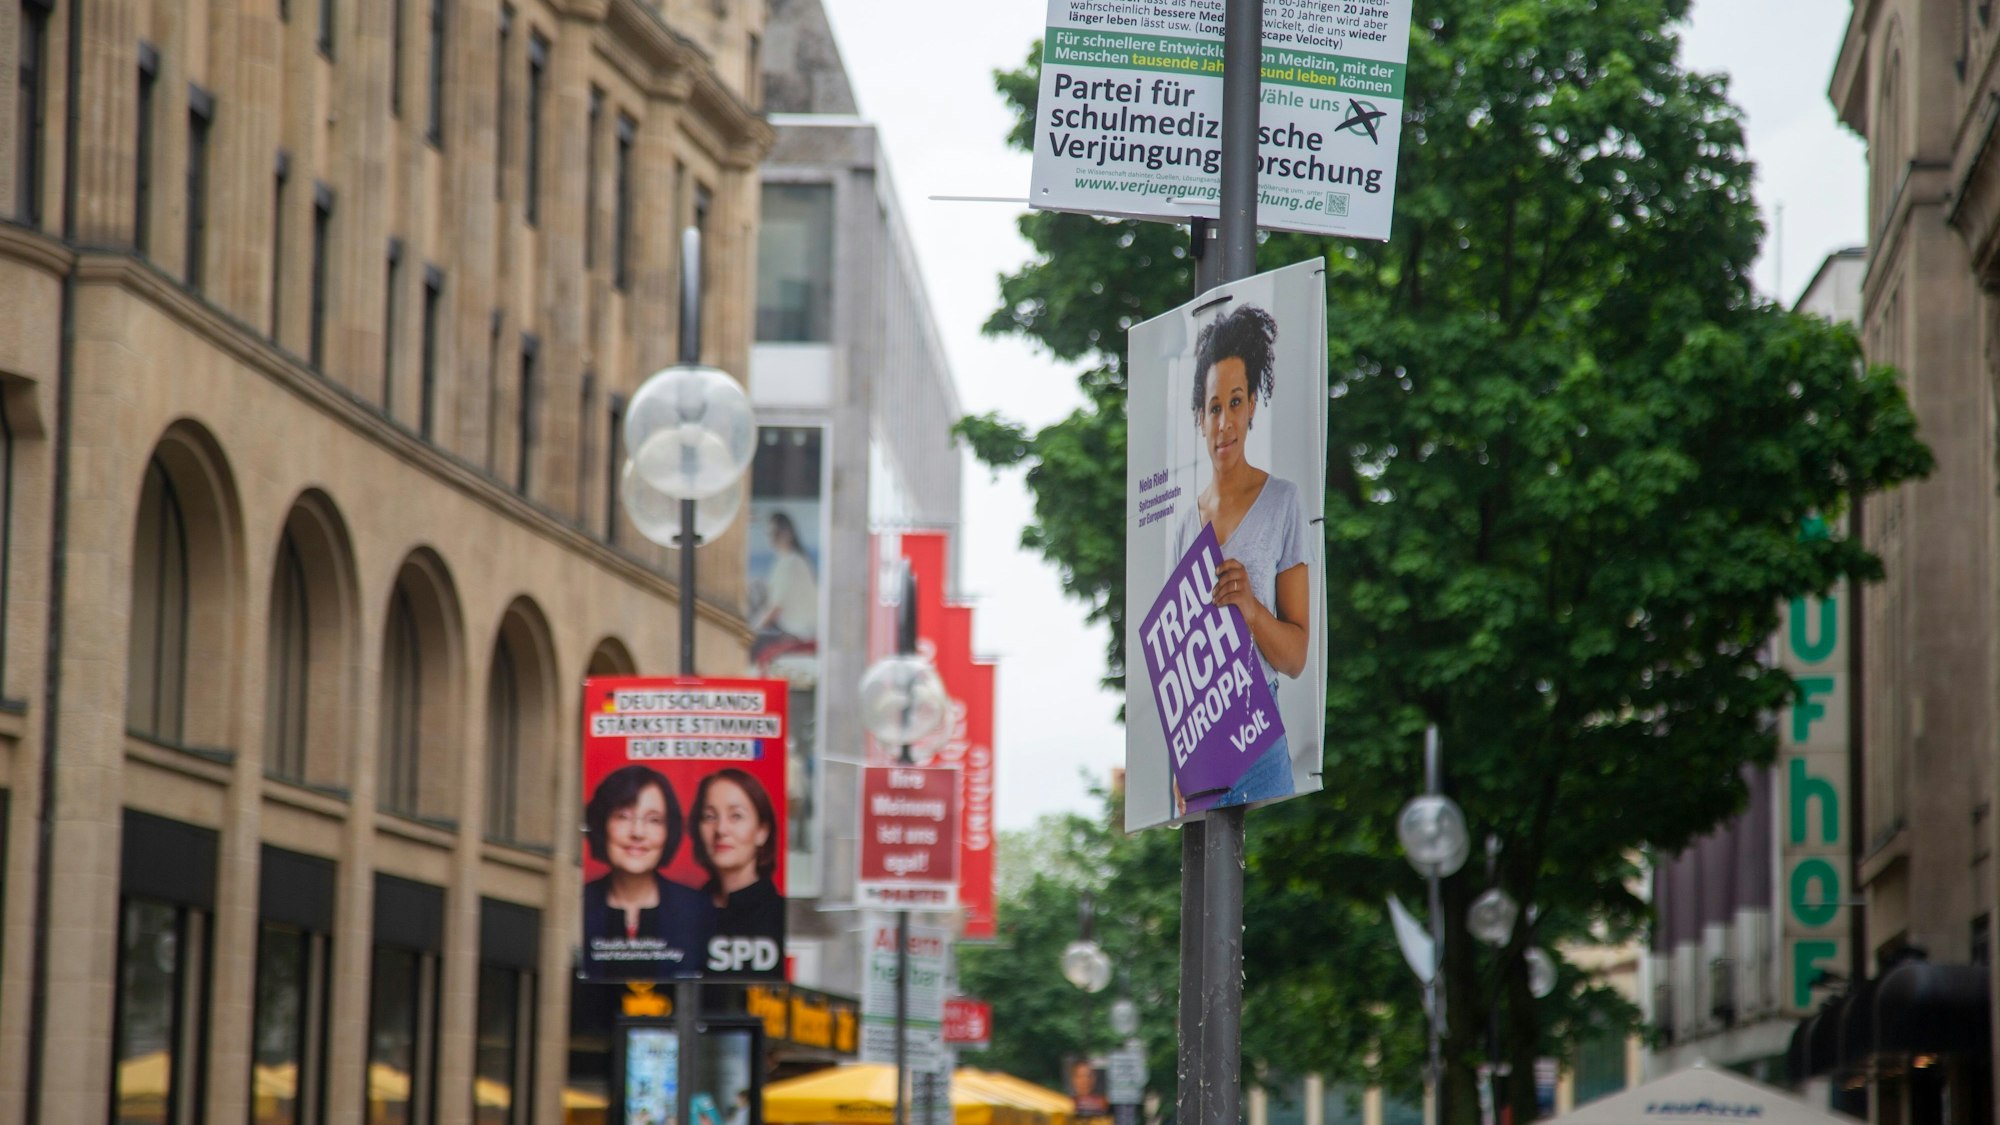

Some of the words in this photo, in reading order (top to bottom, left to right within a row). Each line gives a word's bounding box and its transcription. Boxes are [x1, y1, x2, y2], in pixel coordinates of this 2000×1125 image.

[1070, 2, 1150, 15] wahrscheinlich
[1153, 6, 1196, 20] bessere
[1263, 19, 1305, 33] wickelt,
[1307, 23, 1324, 34] die
[1327, 28, 1346, 37] uns
[1349, 29, 1387, 42] wieder
[1263, 8, 1277, 16] en
[1281, 8, 1295, 18] 20
[1297, 10, 1333, 23] Jahren
[1337, 16, 1360, 27] wird
[1363, 19, 1388, 30] aber
[1343, 4, 1357, 14] 20
[1359, 6, 1389, 19] Jahre
[1069, 11, 1103, 24] länger
[1106, 14, 1137, 26] leben
[1140, 16, 1165, 29] lässt
[1168, 21, 1191, 31] usw.
[1261, 31, 1293, 43] scape
[1295, 33, 1343, 50] Velocity)
[1055, 48, 1129, 64] Menschen
[1132, 53, 1199, 70] tausende
[1201, 58, 1224, 73] Jah
[1260, 67, 1294, 80] sund
[1297, 69, 1337, 86] leben
[1340, 74, 1392, 93] können
[1056, 32, 1079, 46] Für
[1082, 35, 1156, 52] schnellere
[1279, 53, 1339, 73] Medizin,
[1342, 62, 1367, 76] mit
[1369, 64, 1395, 79] der
[1054, 73, 1142, 104] Partei
[1151, 79, 1195, 107] für
[1309, 97, 1340, 112] uns
[1088, 168, 1127, 178] Wissenschaft
[1140, 477, 1152, 494] Nela
[1146, 546, 1219, 673] TRAU
[1158, 605, 1241, 734] DICH
[618, 693, 760, 711] DEUTSCHLANDS
[1172, 658, 1253, 769] EUROPA
[596, 714, 686, 734] STÄRKSTE
[691, 717, 778, 735] STIMMEN
[1230, 708, 1270, 752] Volt
[632, 739, 668, 757] FÜR
[674, 740, 749, 758] EUROPA
[872, 793, 946, 822] Meinung
[877, 824, 902, 844] ist
[905, 827, 938, 845] uns
[708, 936, 780, 972] SPD
